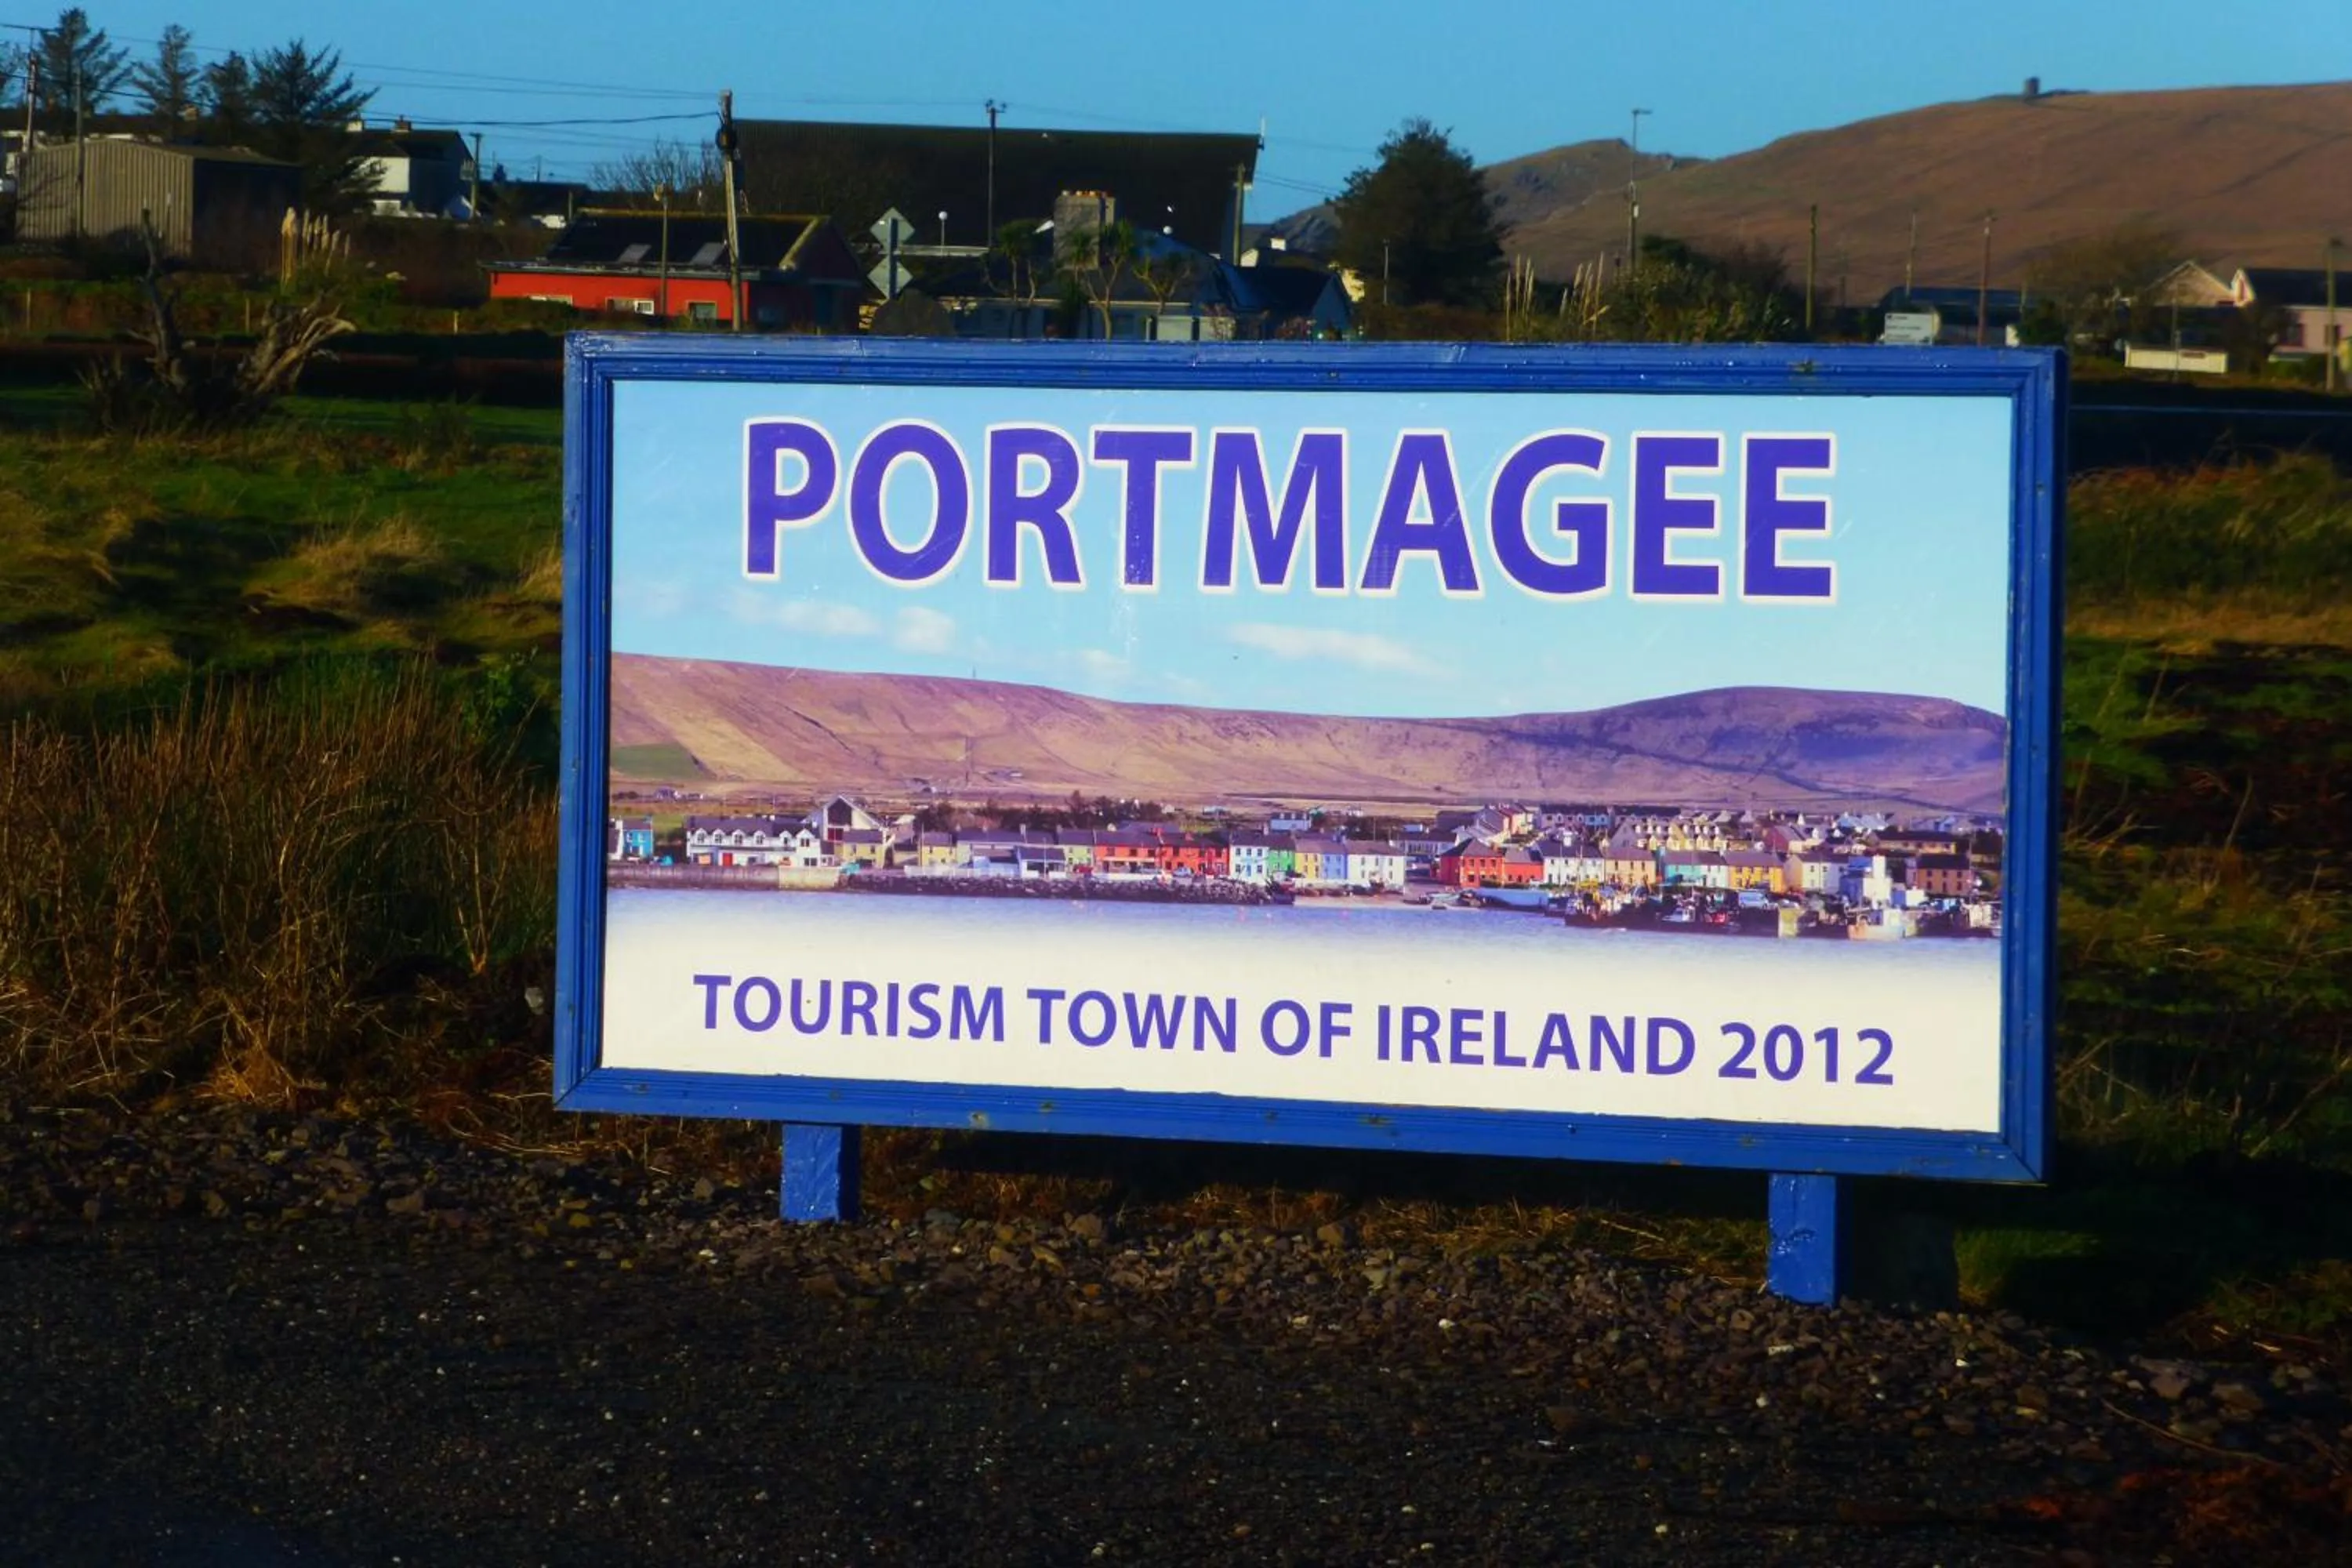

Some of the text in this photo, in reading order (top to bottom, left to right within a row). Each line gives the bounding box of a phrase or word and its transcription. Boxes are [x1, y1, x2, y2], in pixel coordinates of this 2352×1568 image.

[745, 420, 1833, 600] PORTMAGEE
[695, 975, 1893, 1085] TOURISM TOWN OF IRELAND 2012
